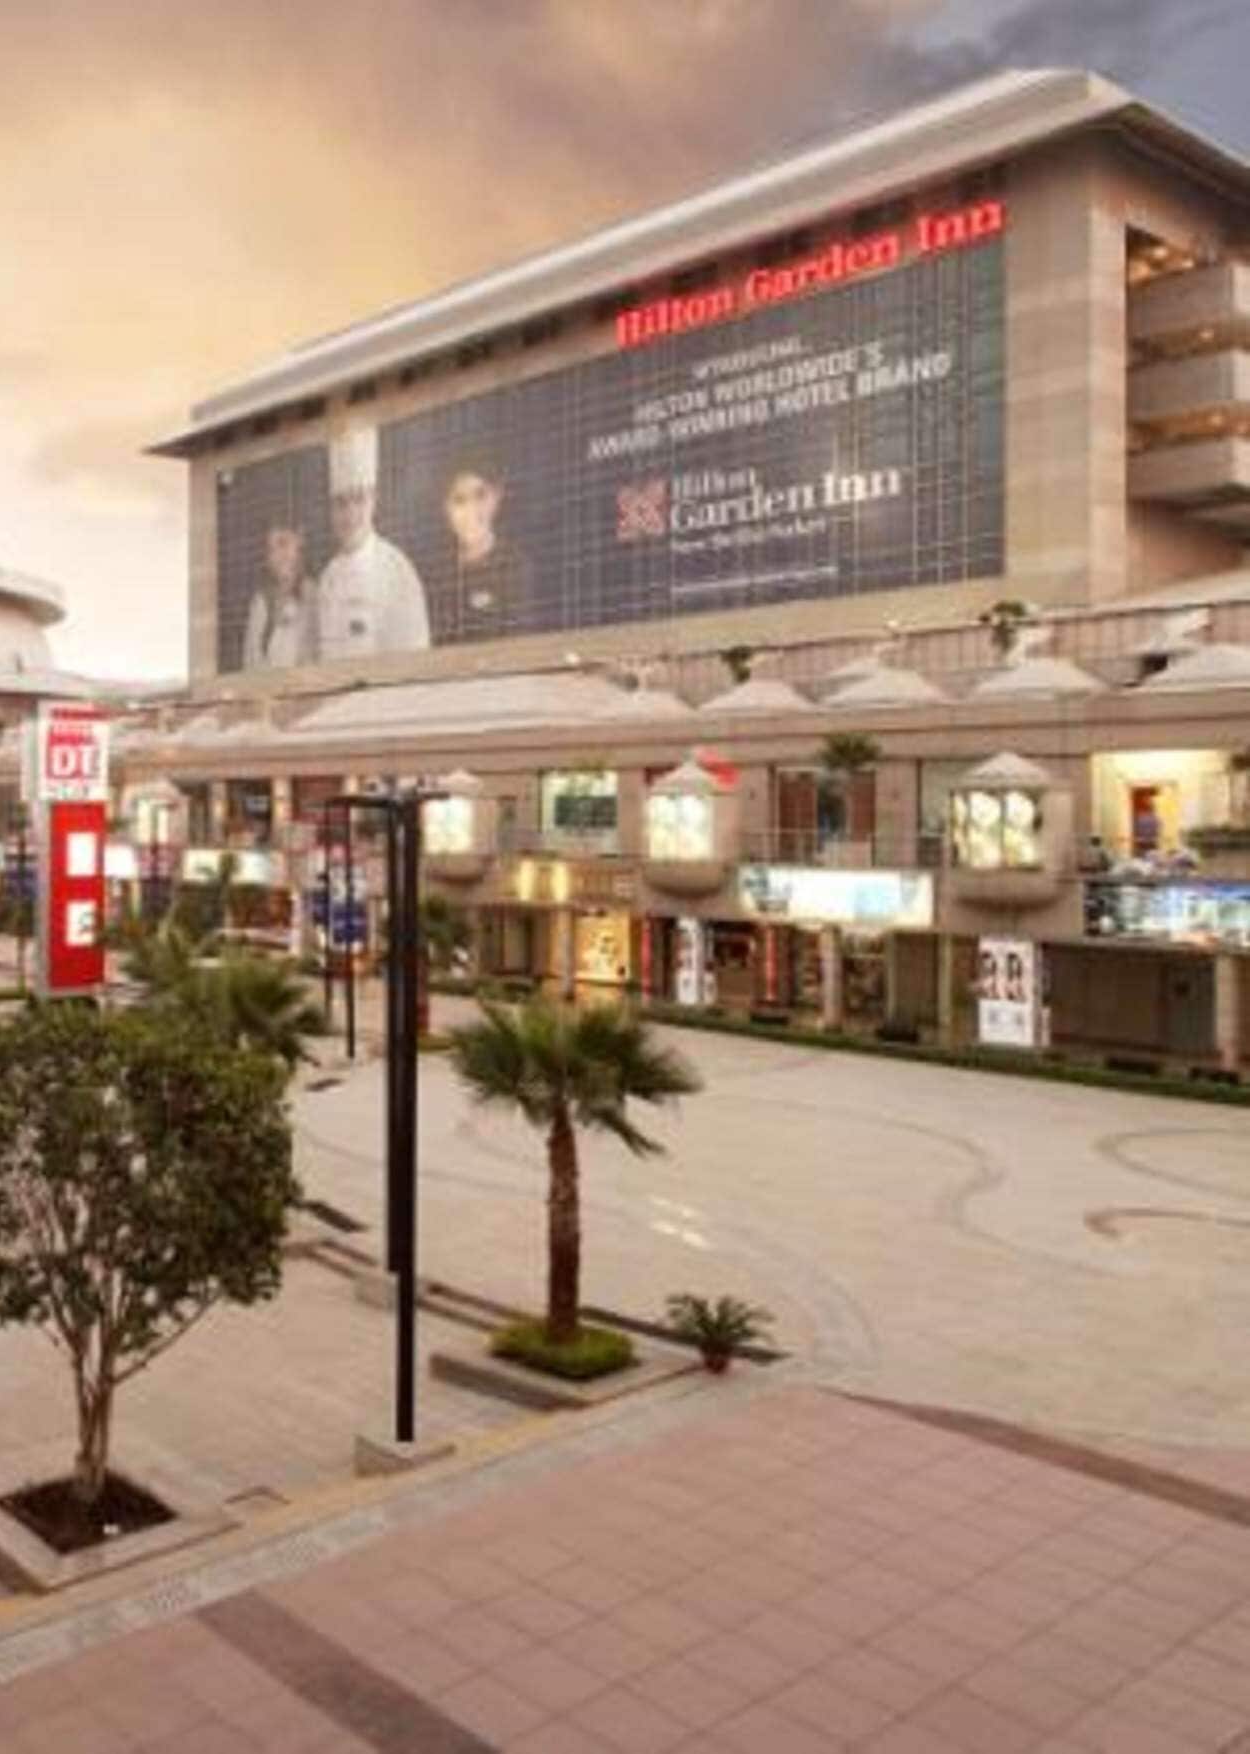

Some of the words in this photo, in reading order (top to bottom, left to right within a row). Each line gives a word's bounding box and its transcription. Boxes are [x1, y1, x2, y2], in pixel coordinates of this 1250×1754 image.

[617, 290, 734, 346] Hilton
[748, 232, 900, 302] Garden
[918, 202, 1004, 252] Inn
[670, 484, 815, 532] Garden
[822, 467, 900, 506] Inn
